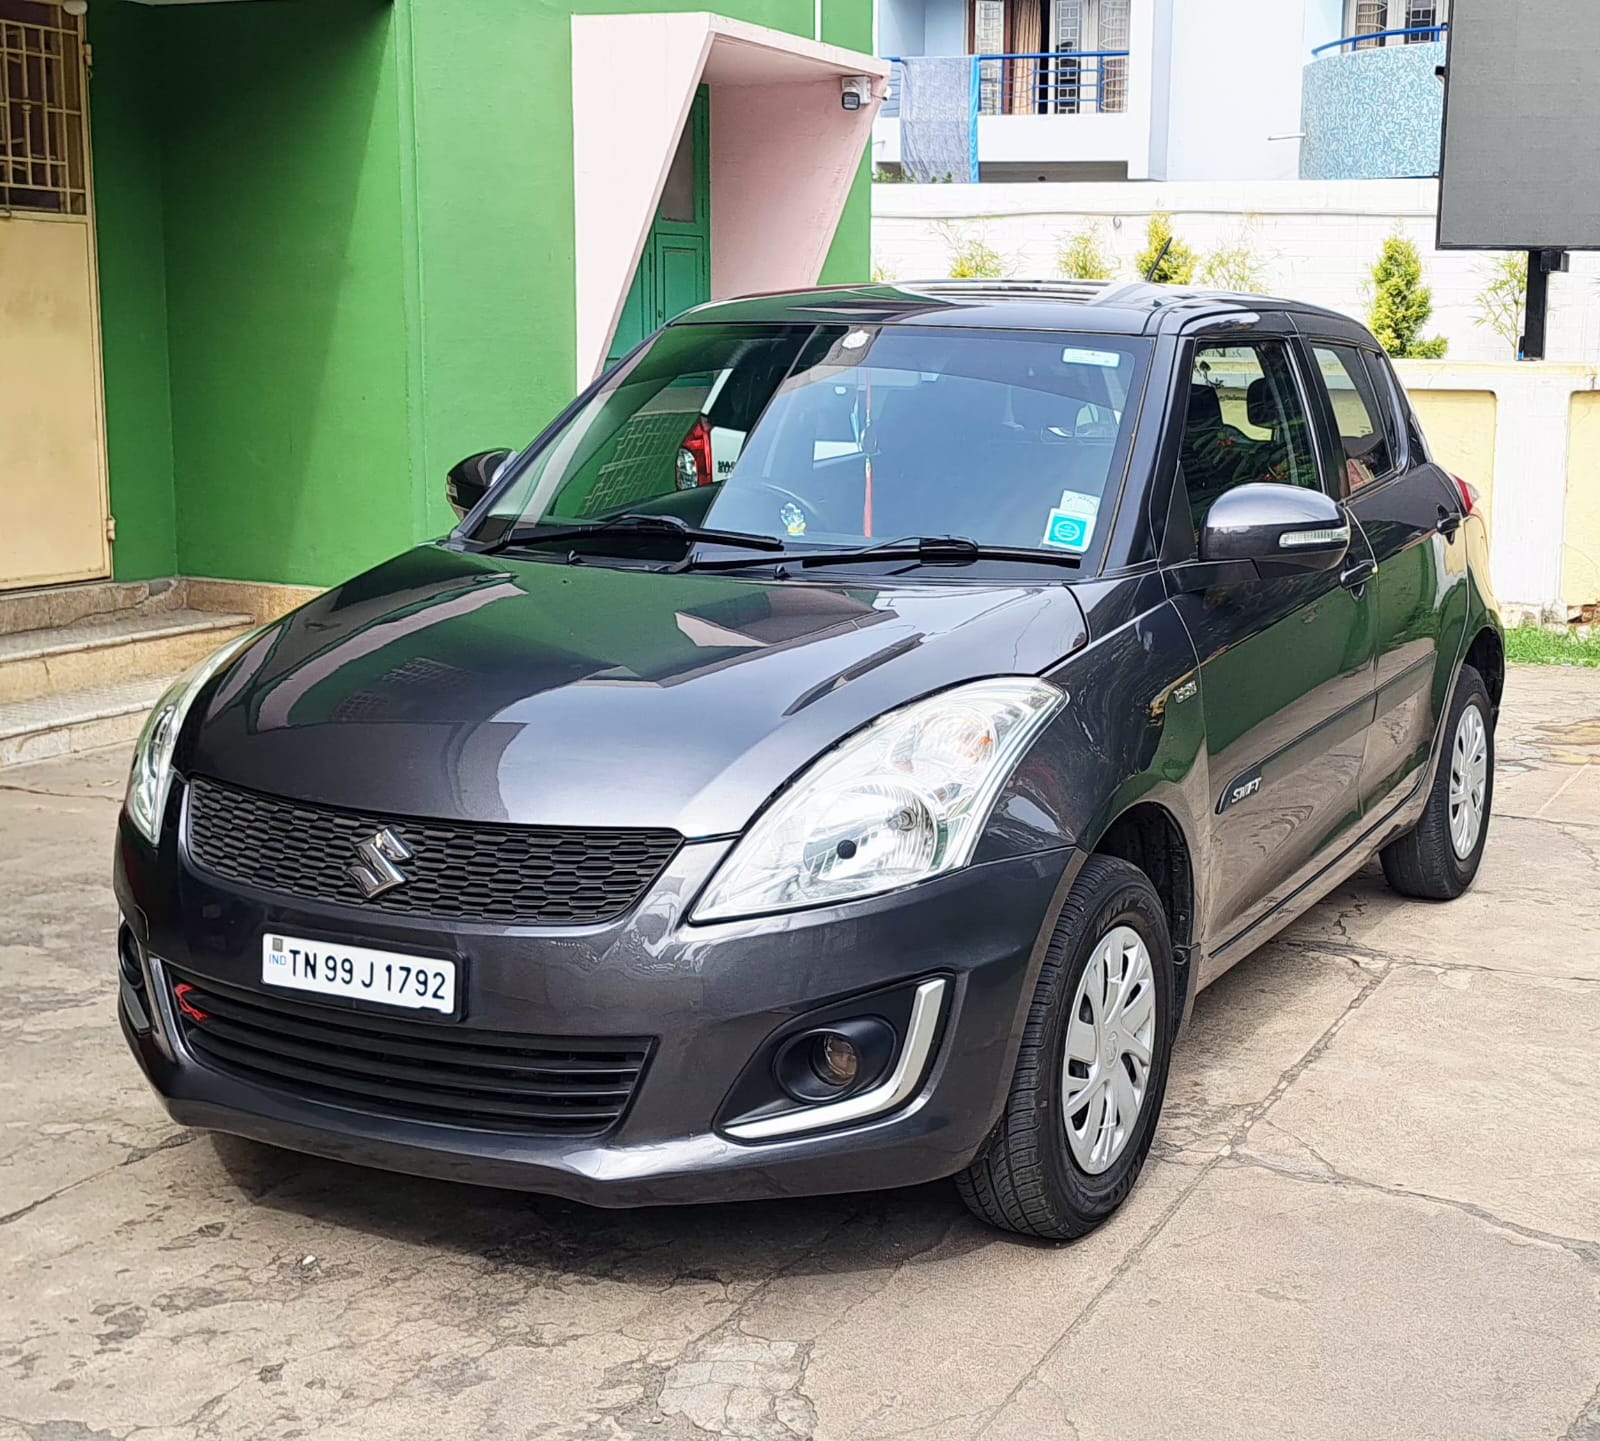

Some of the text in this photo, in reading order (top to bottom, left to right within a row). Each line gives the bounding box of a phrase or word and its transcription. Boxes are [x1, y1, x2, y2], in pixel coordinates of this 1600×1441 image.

[1231, 776, 1263, 804] SWIFT
[268, 953, 287, 967] IND
[289, 949, 446, 1000] TN 99 J 1792
